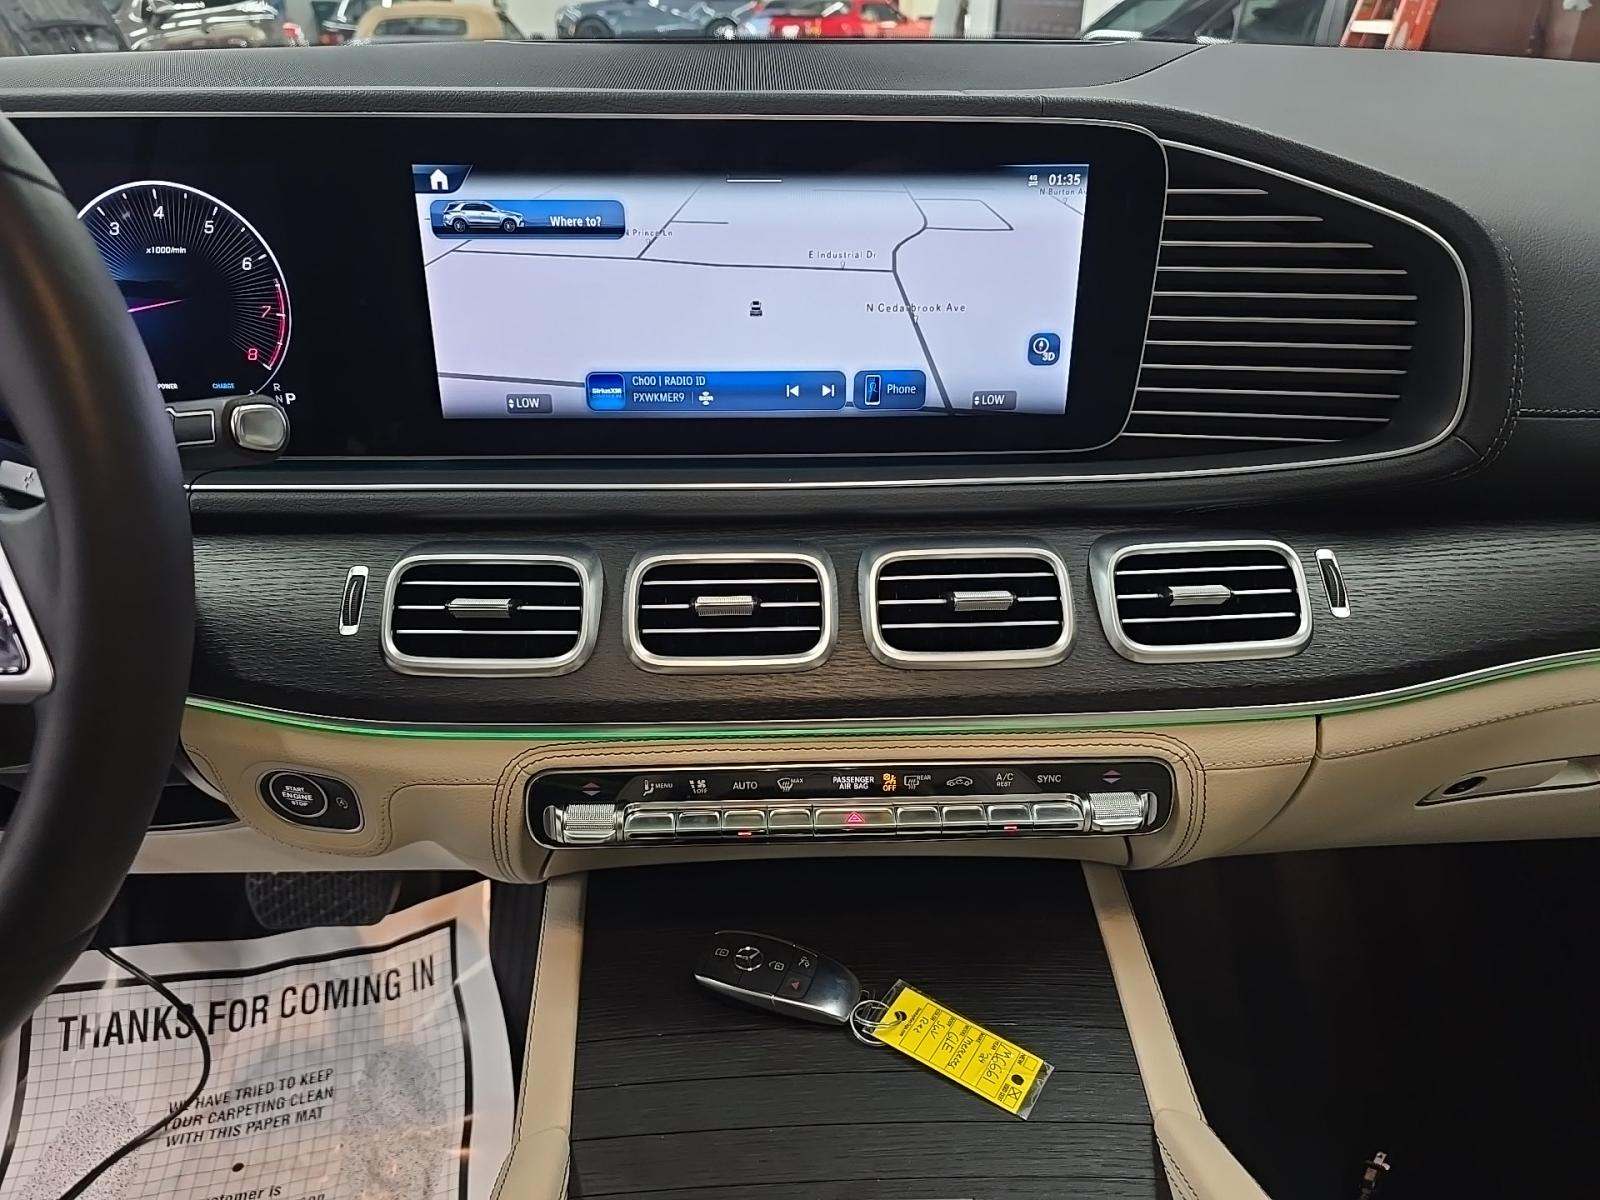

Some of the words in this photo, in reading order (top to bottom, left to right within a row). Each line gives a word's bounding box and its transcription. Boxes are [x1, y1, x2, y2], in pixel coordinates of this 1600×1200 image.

[1048, 173, 1081, 186] 01:35
[1048, 188, 1075, 196] Burton
[153, 206, 164, 219] 4
[204, 220, 214, 234] 5
[549, 216, 582, 227] Where
[586, 216, 602, 228] to?
[109, 222, 120, 236] 3
[146, 246, 187, 255] x1000/min
[808, 251, 814, 259] E
[817, 250, 863, 259] Industrial
[866, 251, 877, 259] Dr
[241, 257, 252, 270] 6
[261, 305, 272, 318] 7
[866, 303, 874, 312] N
[946, 303, 966, 312] Ave
[247, 348, 258, 361] 8
[1042, 351, 1056, 362] 3D
[632, 375, 656, 386] Ch00
[664, 375, 693, 386] RADIO
[695, 375, 706, 386] ID
[273, 383, 281, 392] R
[886, 384, 917, 395] Phone
[285, 392, 297, 404] P
[516, 397, 540, 408] LOW
[632, 392, 685, 403] PXWKMER9
[981, 394, 1005, 405] LOW
[832, 776, 875, 784] PASSENGER
[995, 772, 1014, 781] A/C
[1037, 774, 1062, 784] SYNC
[732, 781, 758, 790] AUTO
[853, 782, 869, 790] BAG
[882, 784, 897, 792] OFF
[57, 1003, 194, 1052] THANKS
[207, 994, 270, 1035] FOR
[280, 968, 401, 1019] COMING
[412, 954, 434, 992] IN
[195, 1092, 231, 1109] HAVE
[236, 1081, 275, 1101] TRIED
[279, 1076, 296, 1090] TO
[300, 1068, 334, 1085] KEEP
[208, 1097, 287, 1123] CARPETING
[290, 1086, 334, 1107] CLEAN
[166, 1131, 204, 1147] WITH
[209, 1123, 242, 1139] THIS
[245, 1113, 291, 1135] PAPER
[295, 1106, 326, 1123] MAT
[269, 1185, 281, 1196] is
